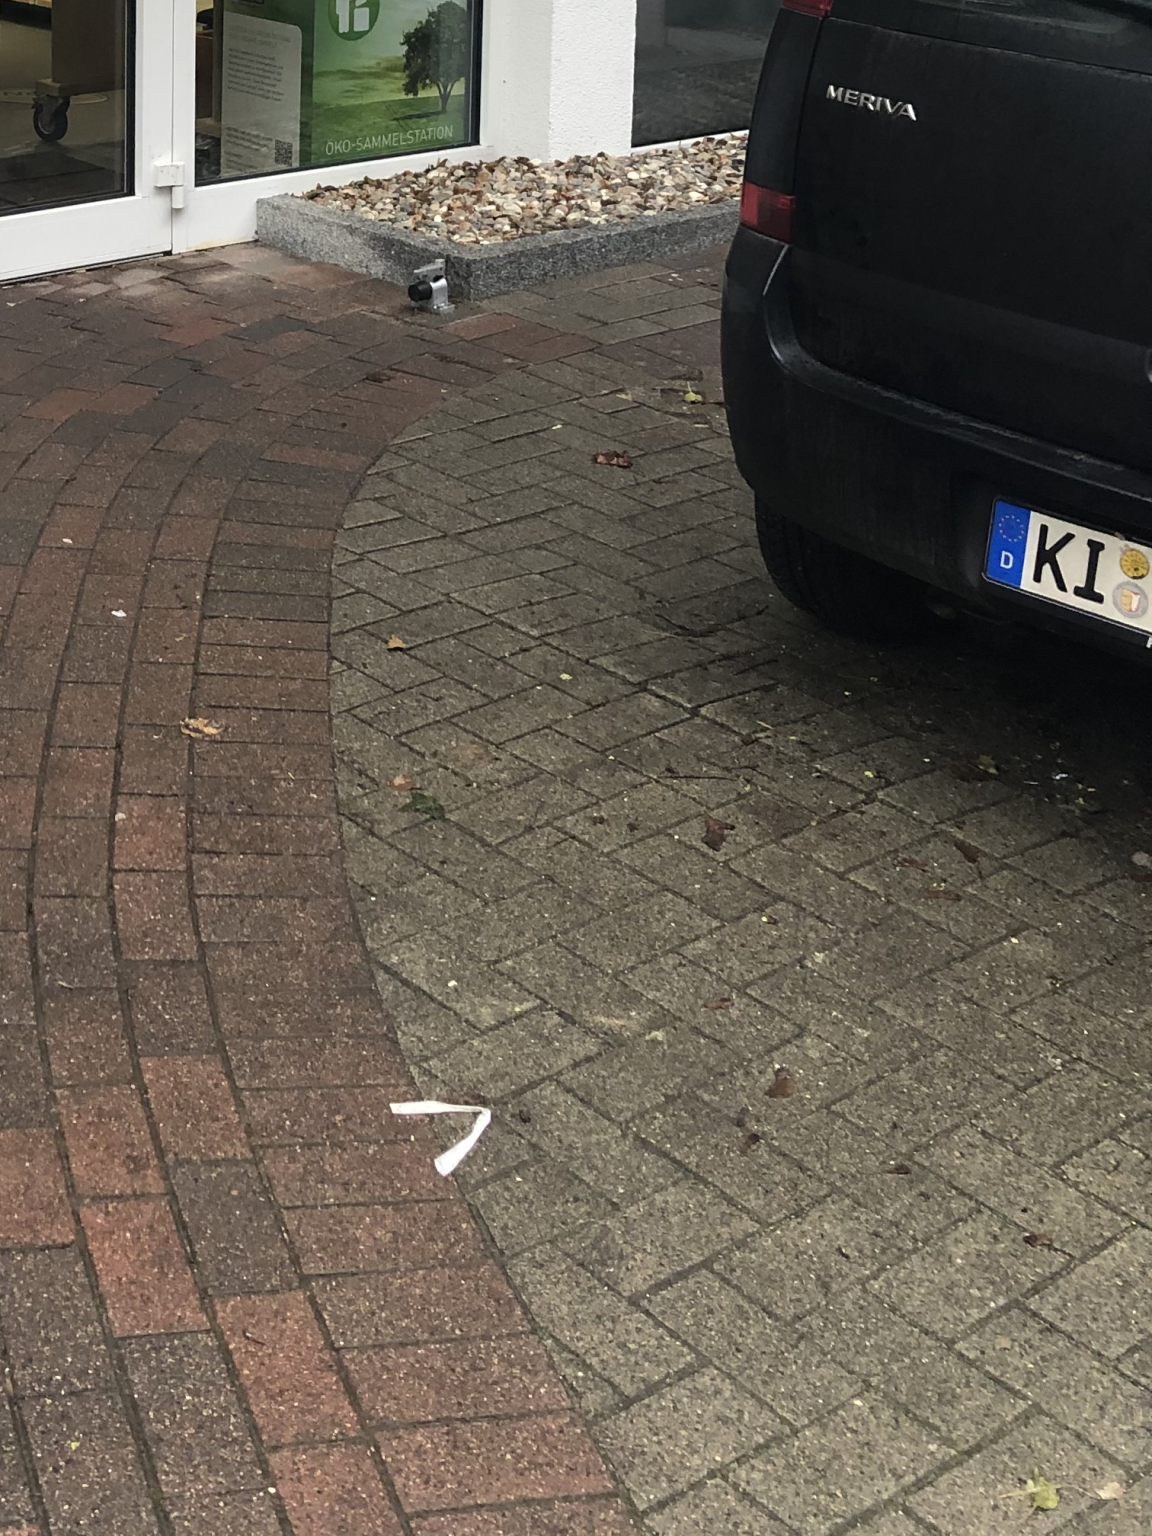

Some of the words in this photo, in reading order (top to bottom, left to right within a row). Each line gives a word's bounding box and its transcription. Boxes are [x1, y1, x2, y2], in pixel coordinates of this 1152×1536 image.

[826, 84, 917, 122] MERIVA
[325, 125, 454, 156] ÖKO-SAMMELSTATION
[1000, 550, 1014, 569] D
[1032, 523, 1105, 605] KI
